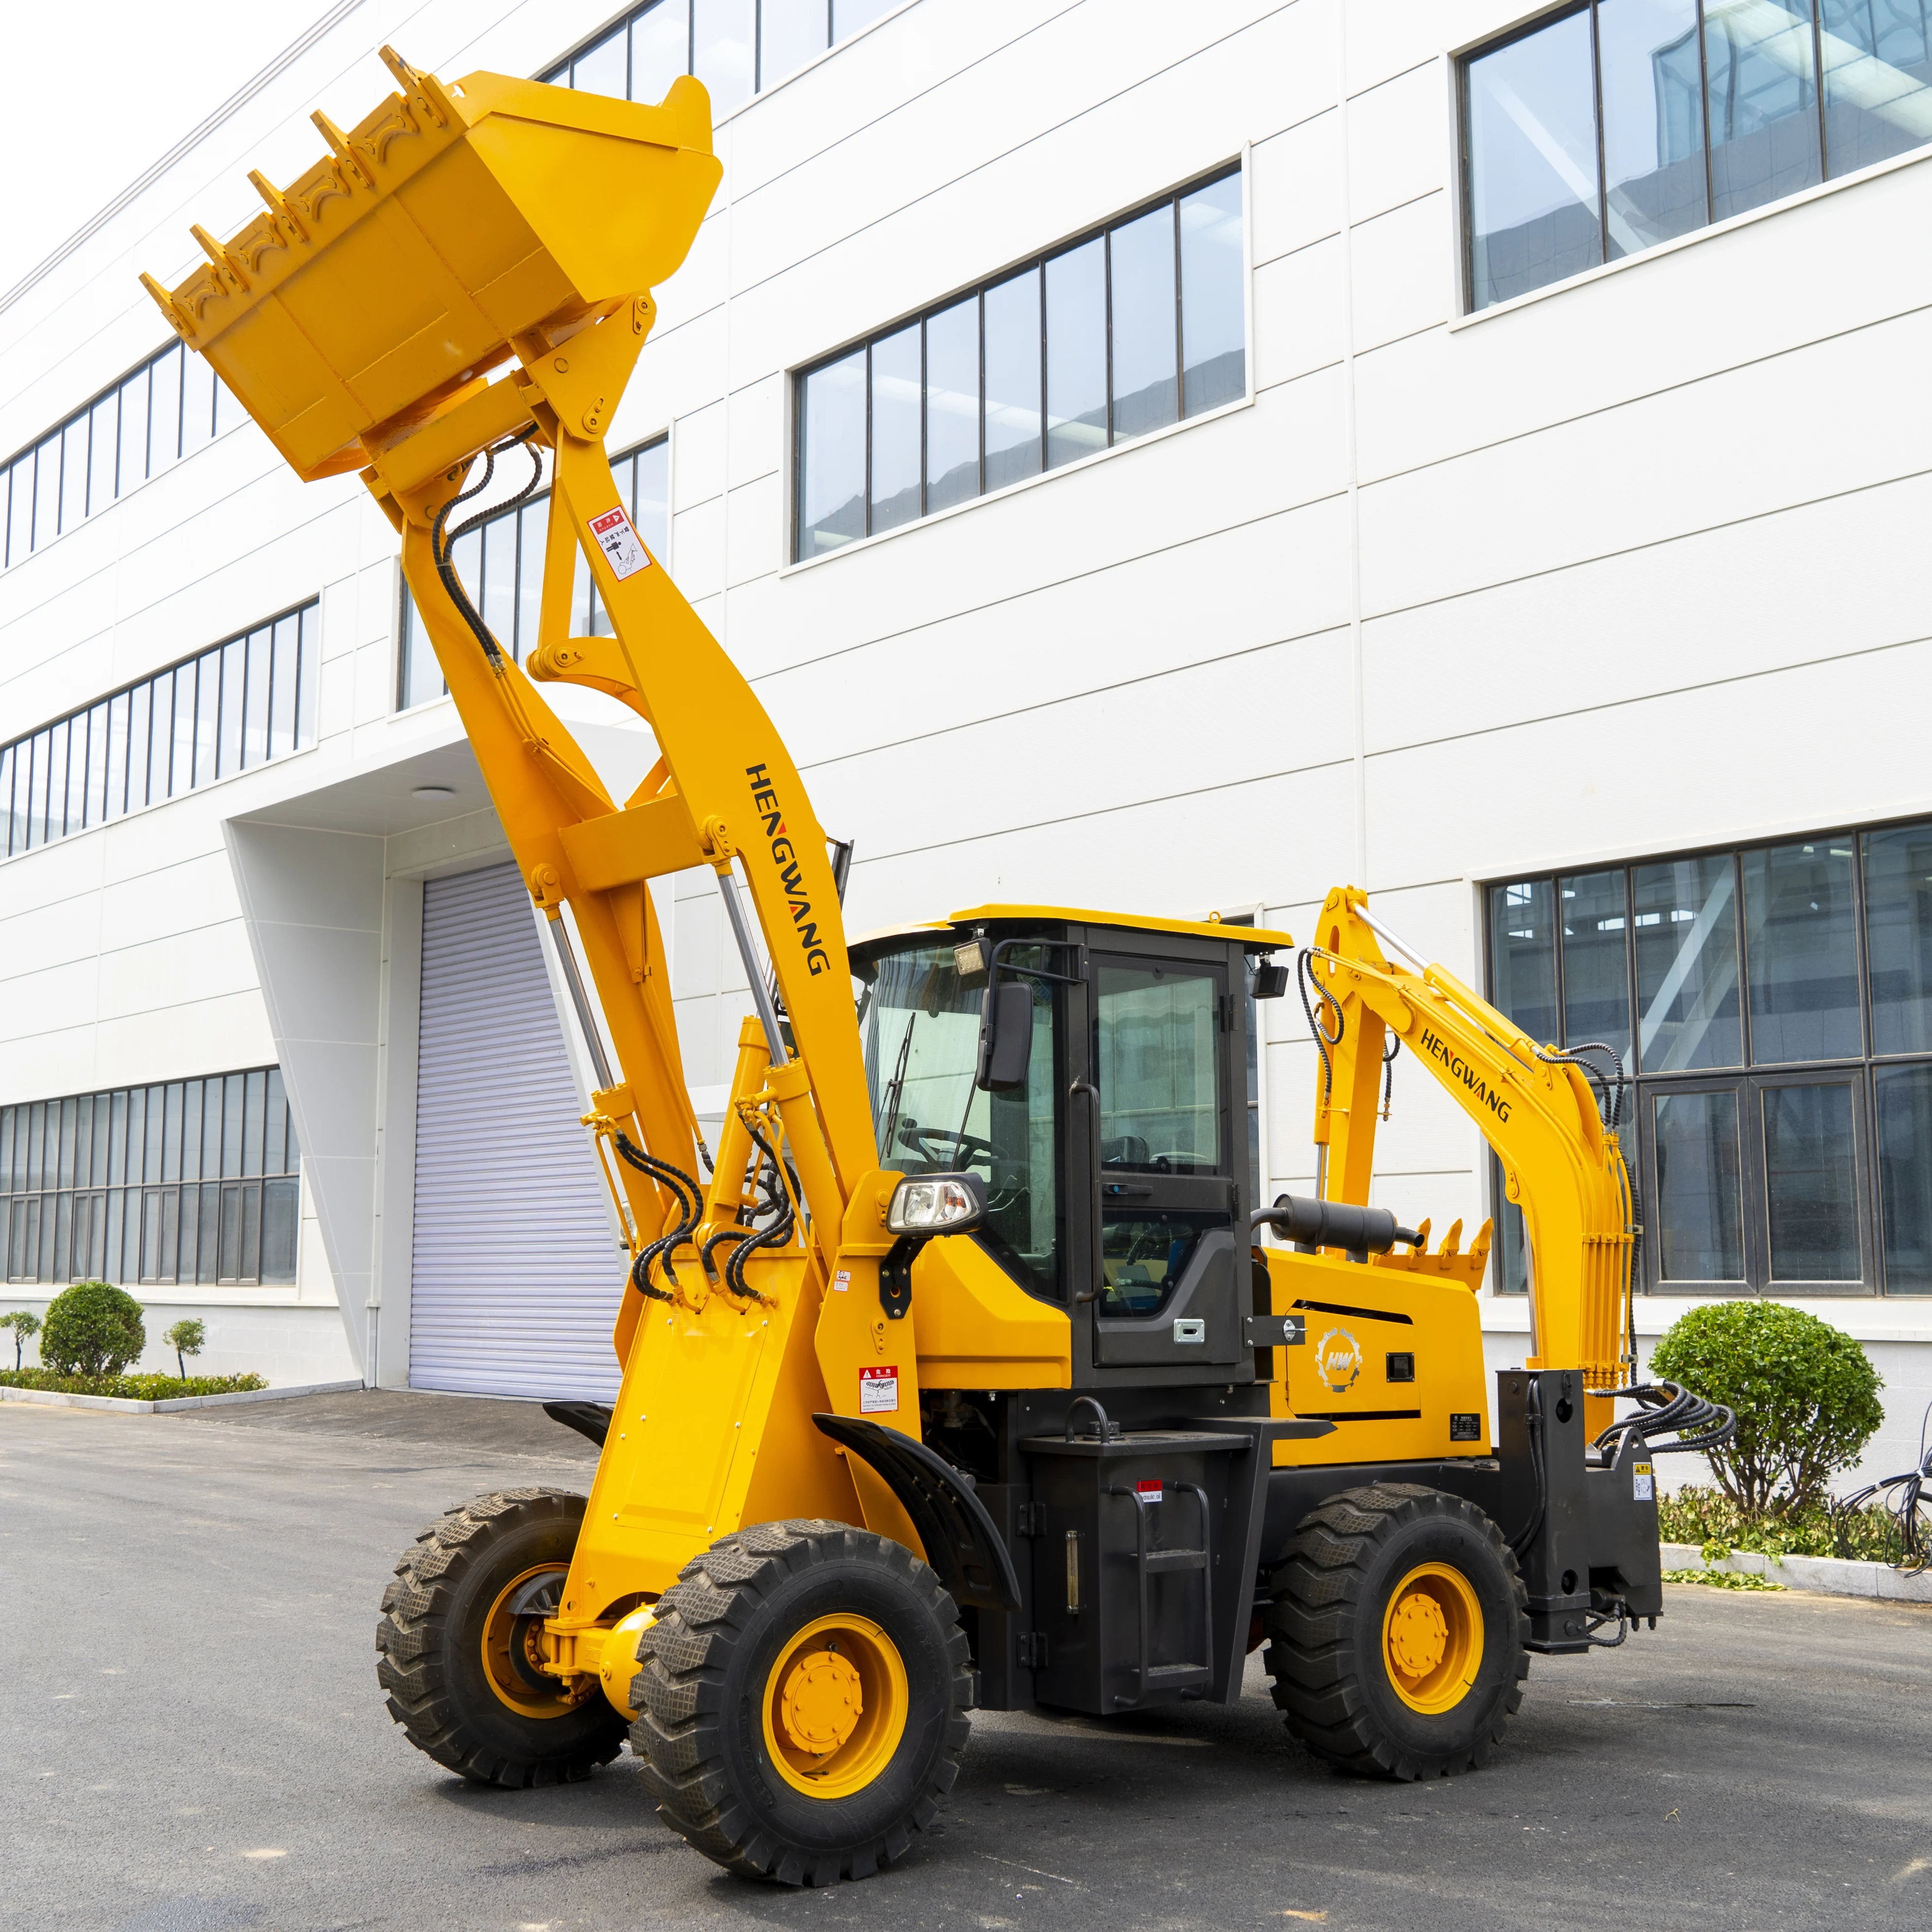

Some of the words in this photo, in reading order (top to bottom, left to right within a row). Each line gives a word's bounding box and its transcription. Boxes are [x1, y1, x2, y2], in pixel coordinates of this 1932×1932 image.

[745, 763, 831, 976] HENGWANG
[1420, 1028, 1513, 1124] HENGWANG
[1325, 1352, 1354, 1371] HW
